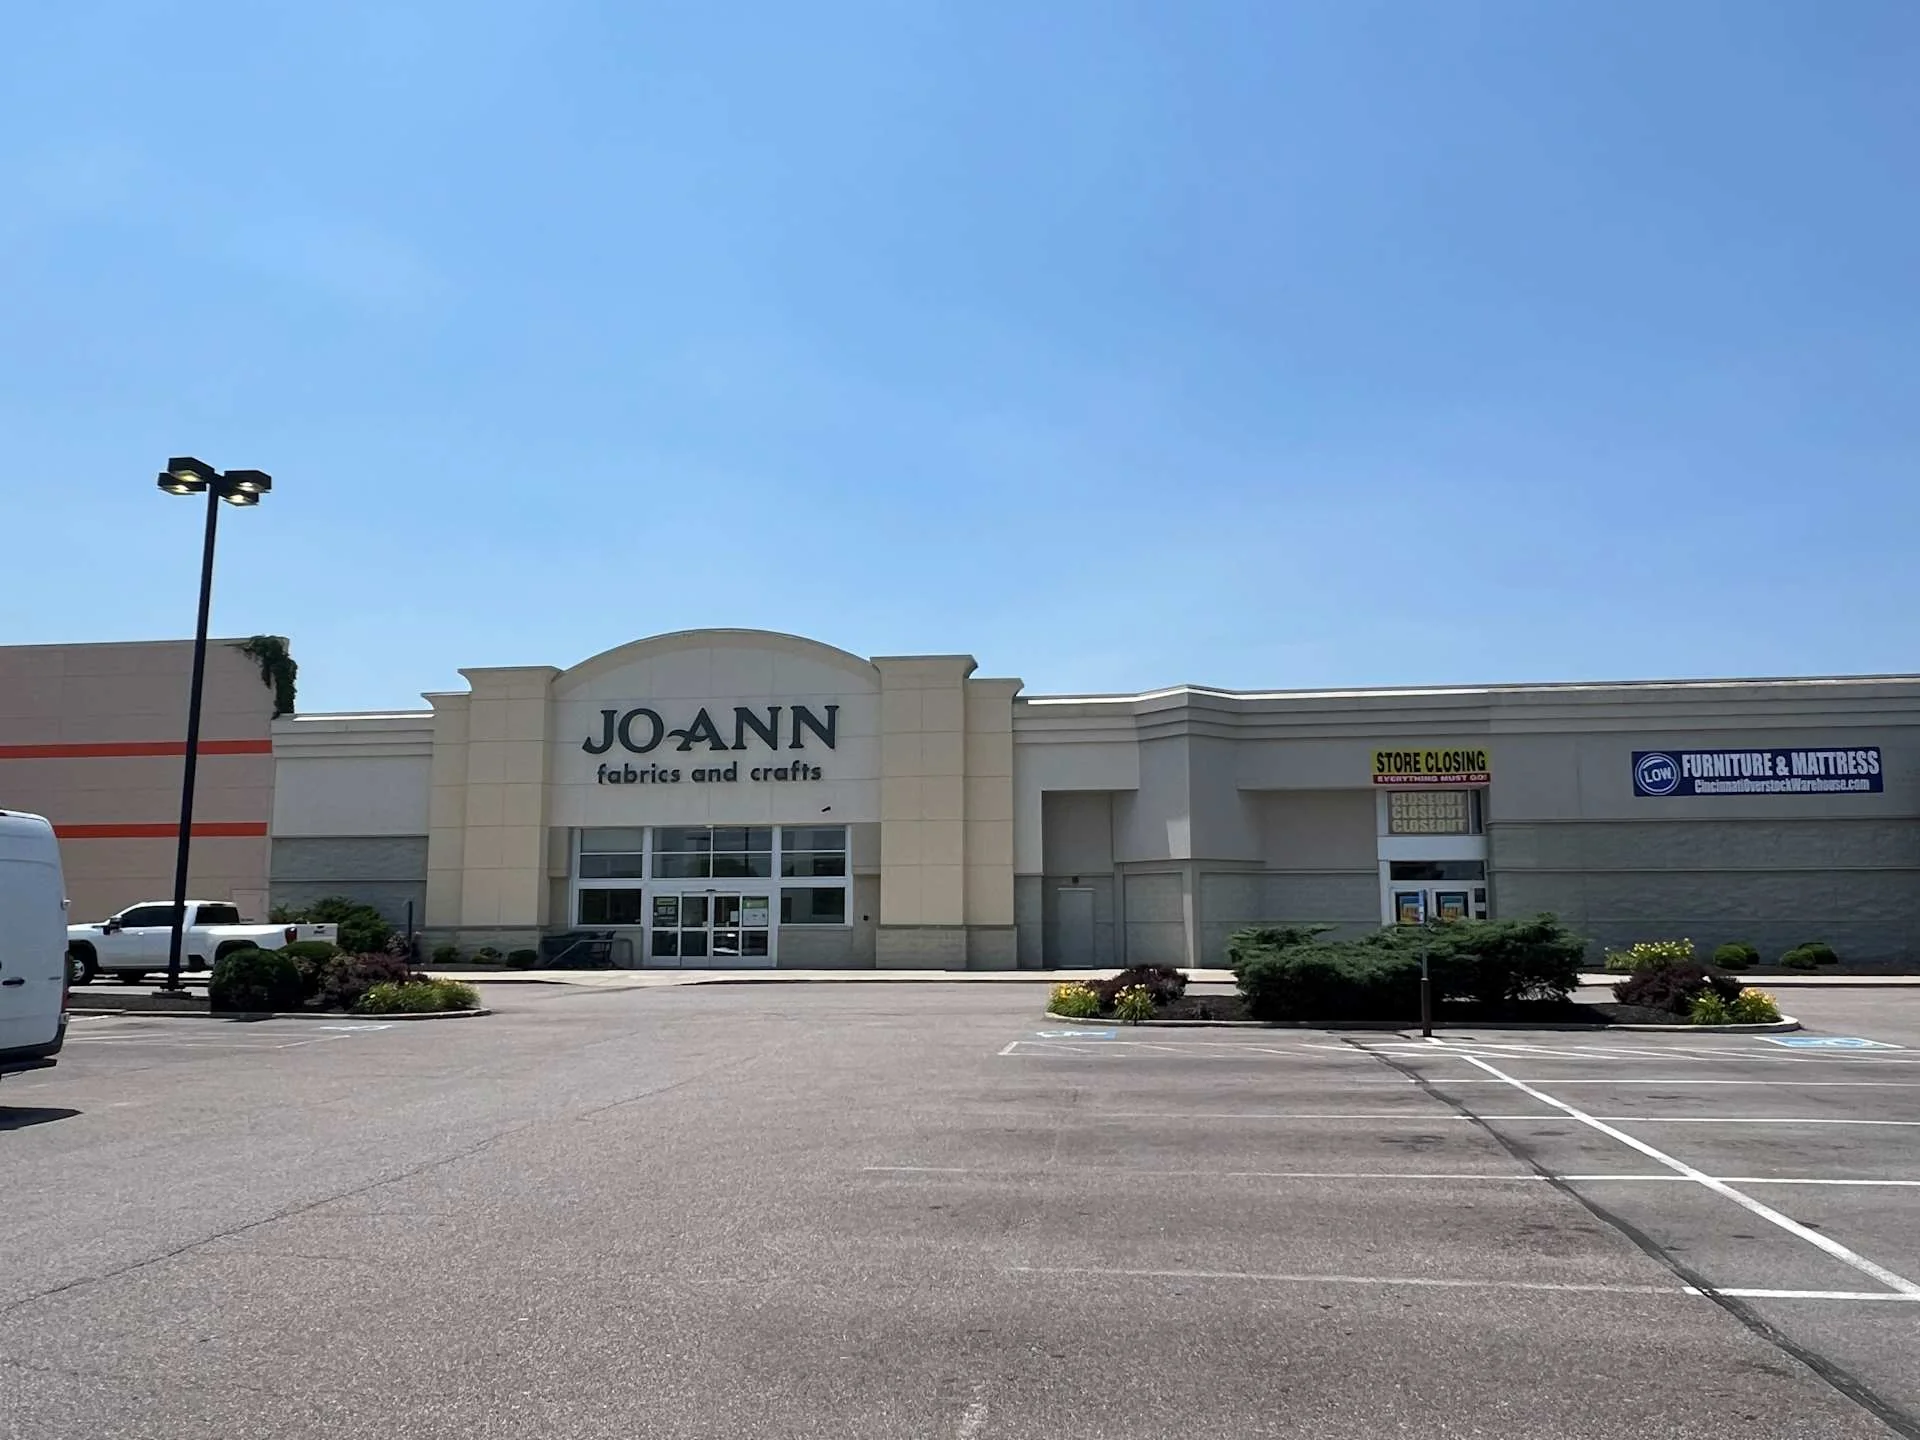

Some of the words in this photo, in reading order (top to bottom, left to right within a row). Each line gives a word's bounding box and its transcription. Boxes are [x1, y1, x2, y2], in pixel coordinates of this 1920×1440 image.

[1376, 752, 1421, 773] STORE
[1425, 751, 1486, 772] CLOSING
[1682, 753, 1773, 778] FURNITURE
[1776, 756, 1790, 776] &
[1791, 751, 1880, 776] MATTRESS
[597, 763, 681, 785] fabrics
[691, 761, 738, 783] and
[750, 760, 822, 782] crafts
[1377, 775, 1438, 783] EVERYTHING
[1440, 774, 1468, 782] MUST
[1391, 792, 1465, 805] CLOSEOUT
[1391, 806, 1465, 819] CLOSEOUT
[1391, 819, 1465, 833] CLOSEOUT
